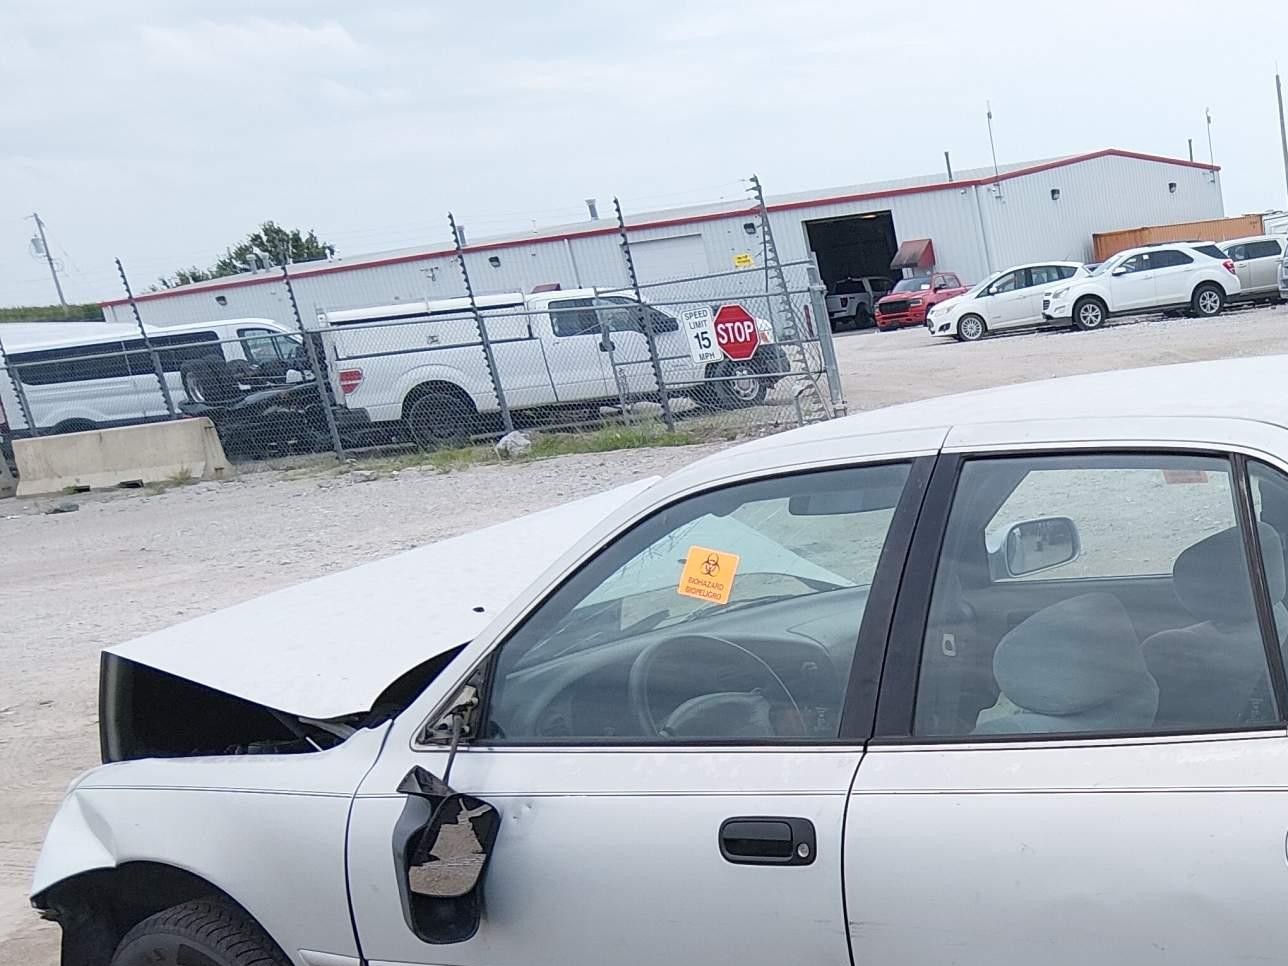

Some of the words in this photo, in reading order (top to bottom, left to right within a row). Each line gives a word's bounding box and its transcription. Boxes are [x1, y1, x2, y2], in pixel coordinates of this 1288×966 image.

[684, 309, 708, 321] SPEED
[688, 319, 708, 330] LIMIT
[717, 320, 753, 344] STOP
[694, 331, 711, 350] 15
[699, 352, 715, 361] MPH
[687, 576, 724, 591] BIOHAZARD
